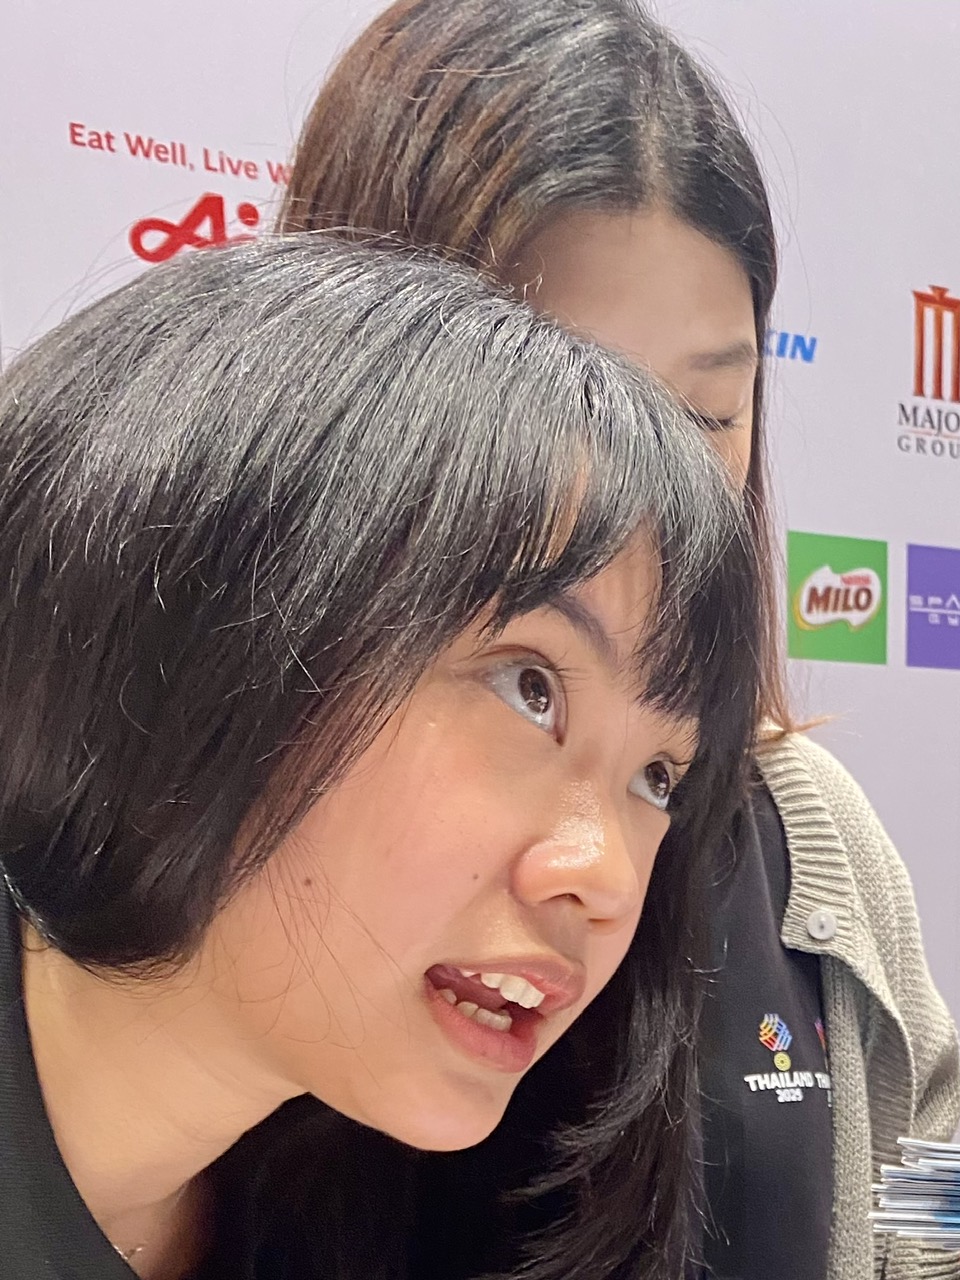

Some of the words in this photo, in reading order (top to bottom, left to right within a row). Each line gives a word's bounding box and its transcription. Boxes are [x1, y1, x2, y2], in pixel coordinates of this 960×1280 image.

[68, 122, 116, 154] Eat
[123, 132, 195, 172] Well,
[203, 148, 258, 181] Live
[266, 160, 293, 187] W
[805, 585, 873, 614] MILO
[743, 1071, 815, 1092] THAILAND
